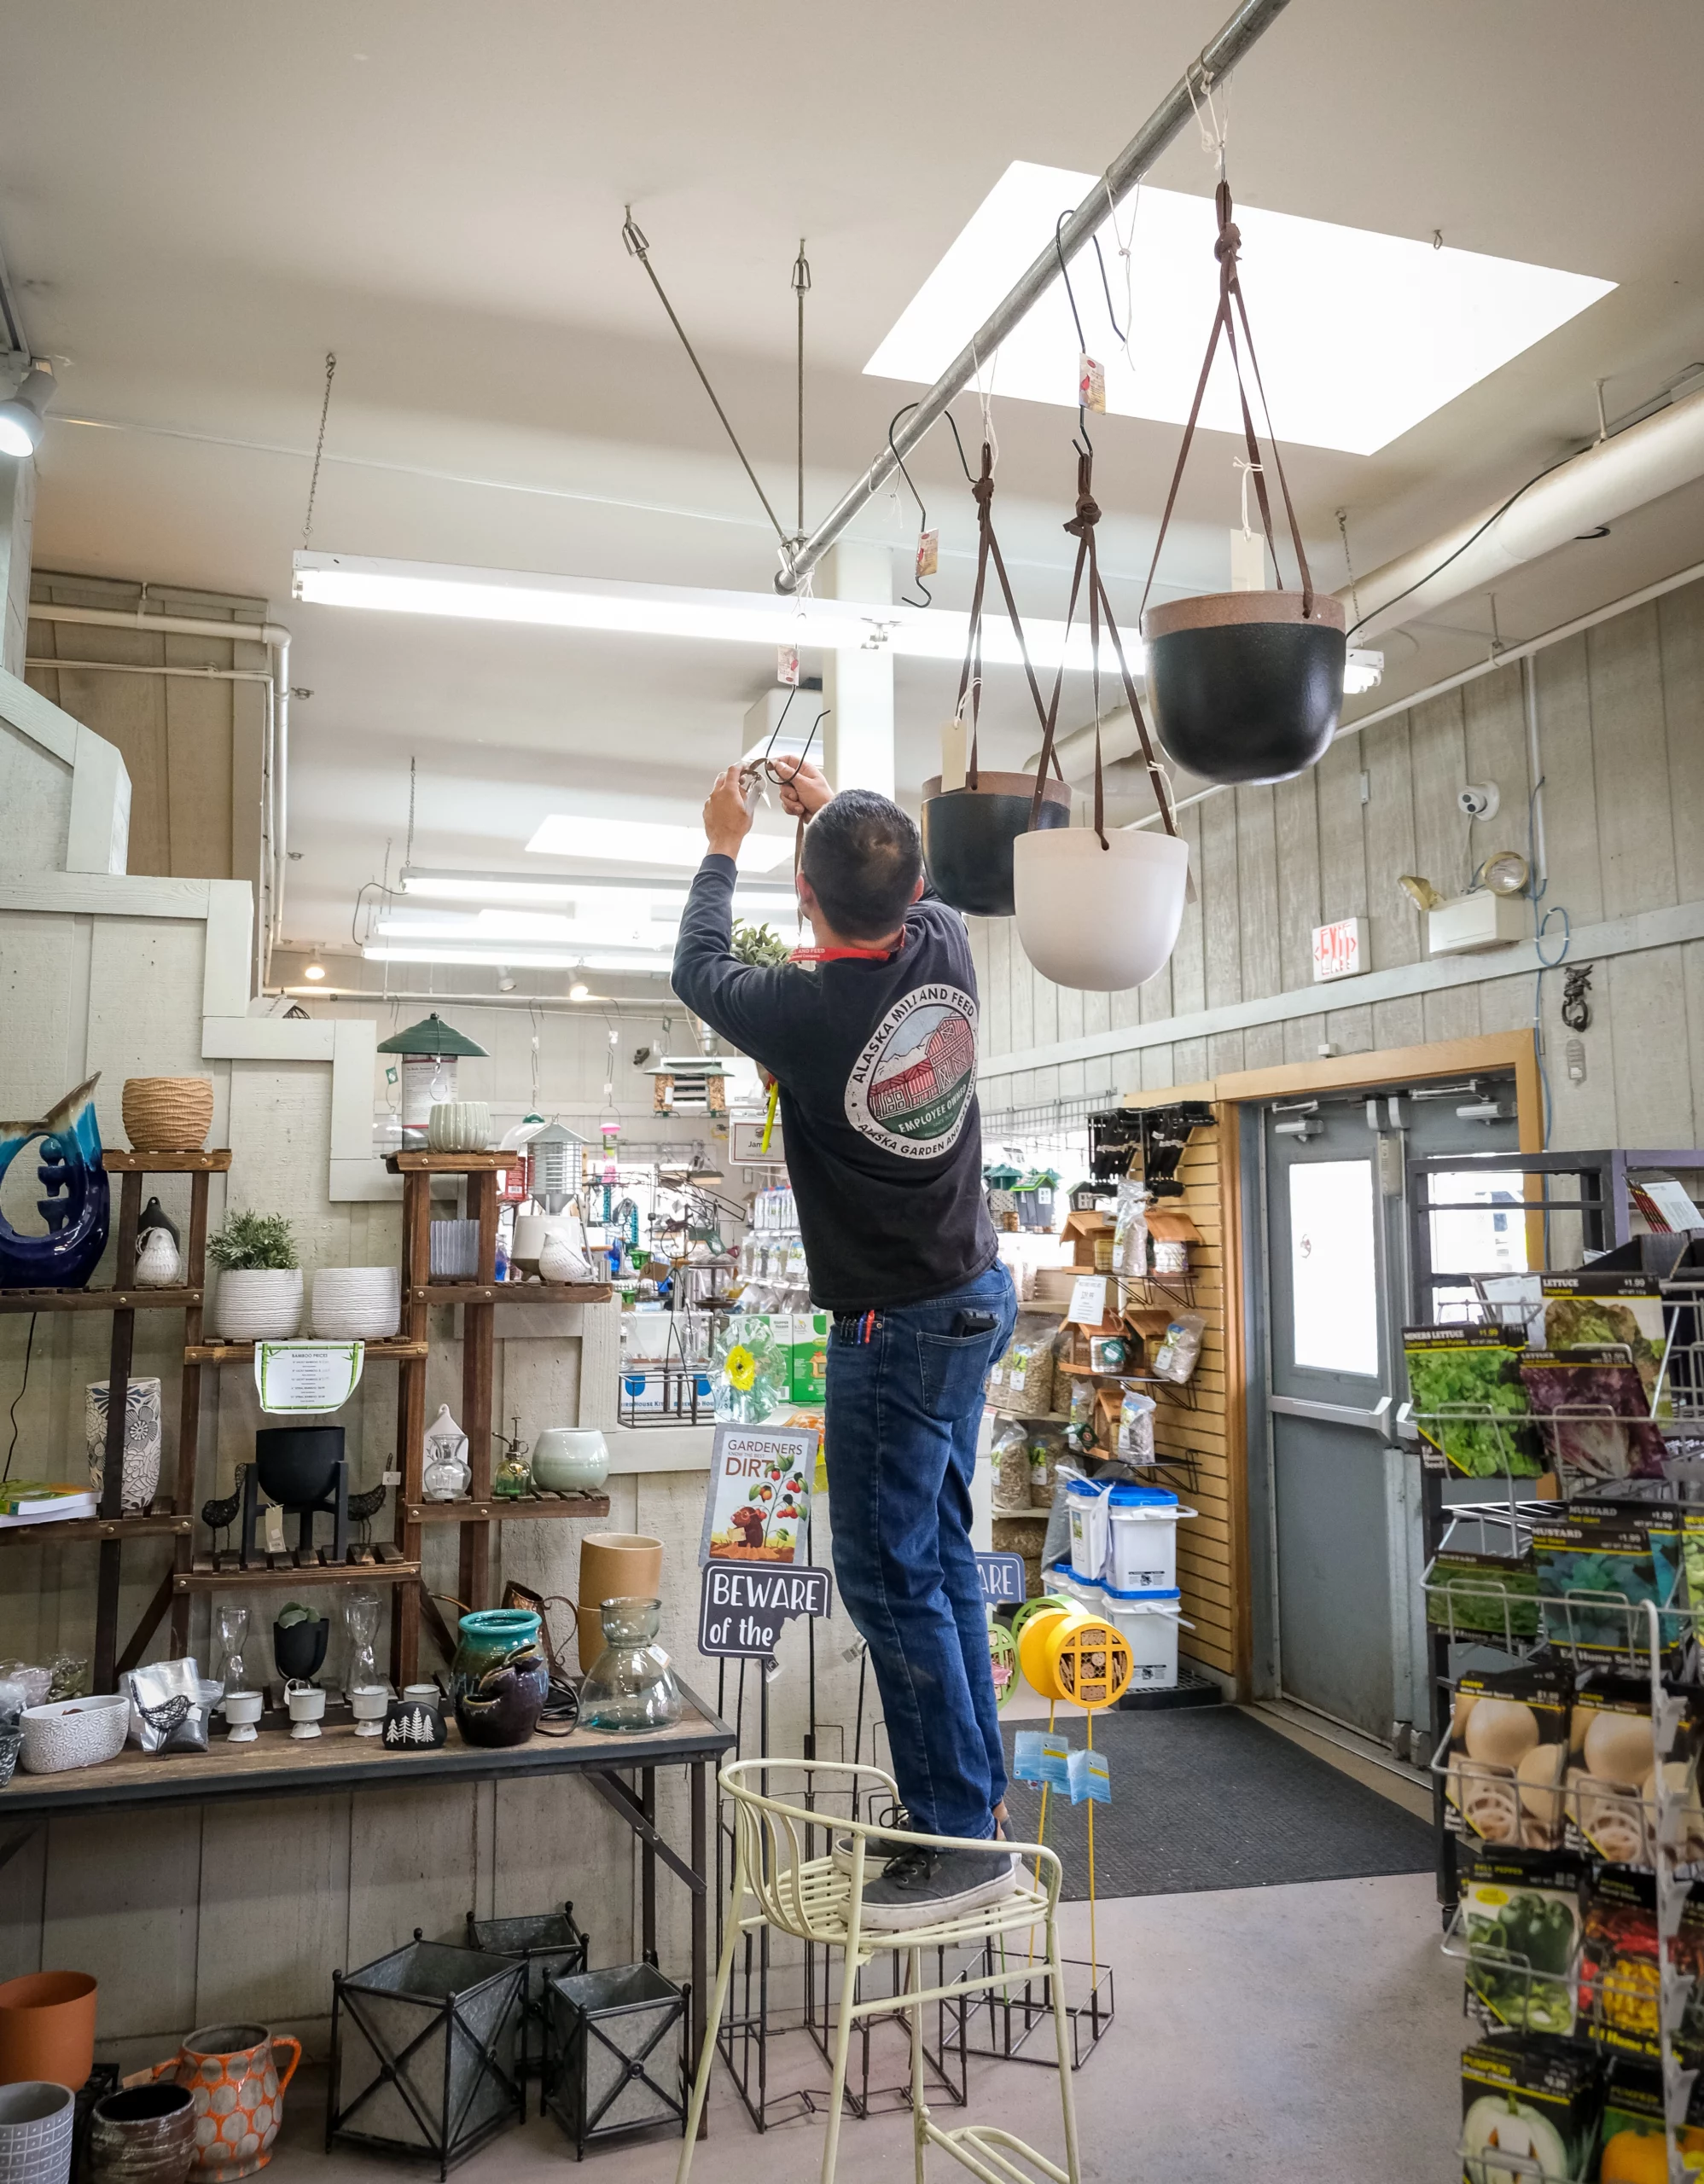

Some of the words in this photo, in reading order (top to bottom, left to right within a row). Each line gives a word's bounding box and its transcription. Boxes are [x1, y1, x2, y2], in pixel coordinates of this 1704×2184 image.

[1320, 922, 1351, 975] EXIT
[852, 1022, 895, 1084] ALASKA
[891, 994, 918, 1023] MILL
[919, 988, 948, 1002] AND
[951, 991, 974, 1018] FEED
[898, 1103, 946, 1133] EMPLOYEE
[946, 1083, 968, 1111] OWNED
[858, 1124, 898, 1151] ALASKA
[900, 1141, 945, 1156] GARDEN
[946, 1124, 960, 1147] AND
[1543, 1278, 1579, 1288] LETTUCE
[1432, 1330, 1465, 1339] LETTUCE
[728, 1439, 803, 1455] GARDENERS
[724, 1456, 775, 1478] DIRT
[1568, 1506, 1618, 1517] MUSTARD
[1651, 1511, 1674, 1521] $1.99
[1532, 1526, 1583, 1539] MUSTARD
[713, 1573, 820, 1611] BEWARE
[709, 1617, 732, 1644] of
[739, 1615, 773, 1647] the
[1578, 1650, 1613, 1663] Hume
[1607, 2030, 1643, 2053] Hume
[1463, 2054, 1511, 2077] PUMPKIN
